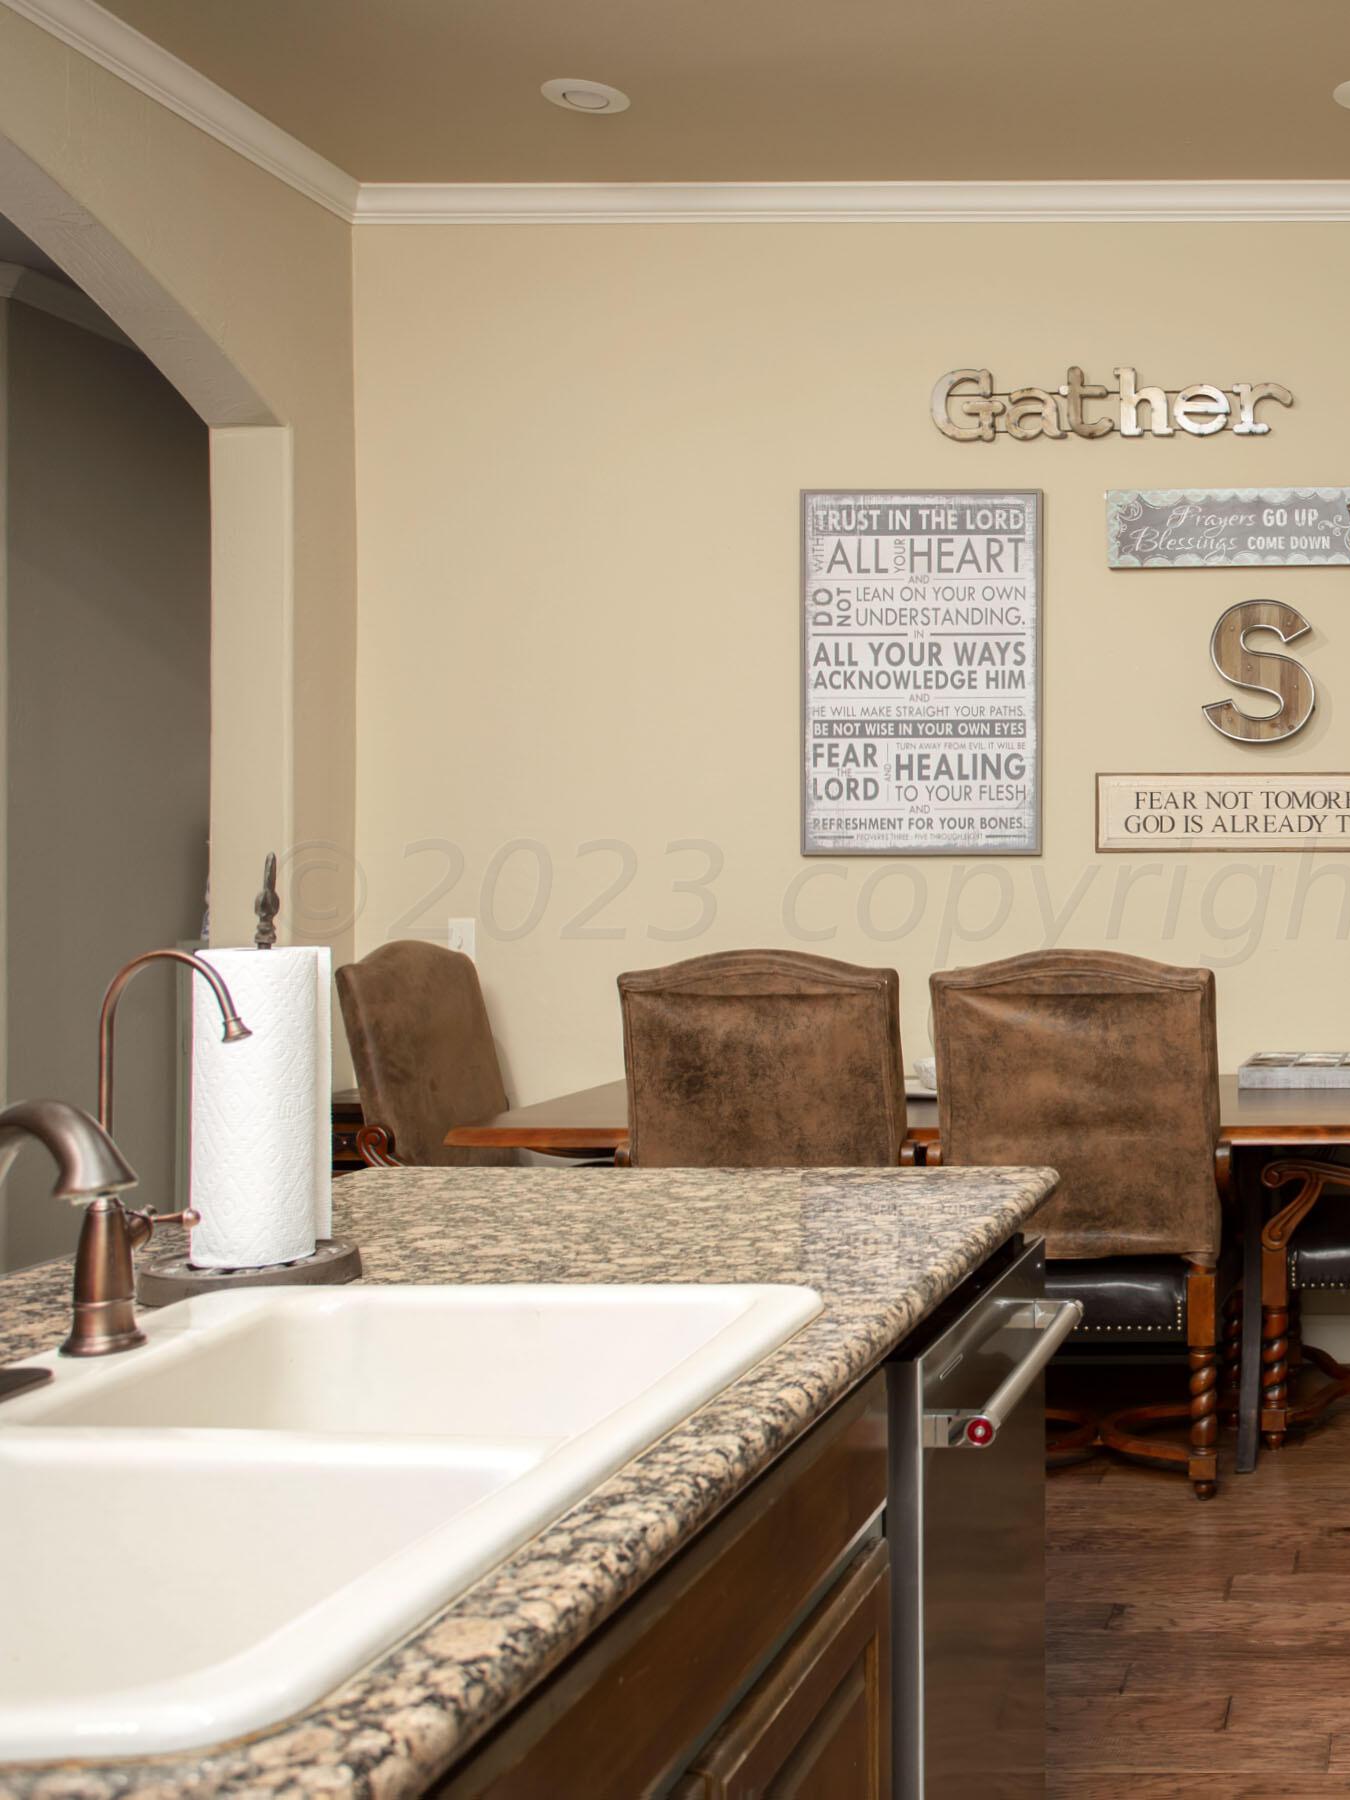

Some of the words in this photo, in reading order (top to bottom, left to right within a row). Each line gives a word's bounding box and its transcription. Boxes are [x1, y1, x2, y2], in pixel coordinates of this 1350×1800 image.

[931, 366, 1294, 441] Gather
[816, 510, 881, 530] TRUST
[888, 510, 910, 530] IN
[919, 510, 958, 530] THE
[966, 510, 1024, 530] LORD
[1167, 506, 1256, 539] Prayers
[1263, 508, 1287, 527] GO
[1295, 508, 1319, 526] UP
[812, 536, 824, 572] WITH
[1128, 528, 1238, 563] Blessings
[1247, 536, 1285, 550] COME
[1290, 536, 1330, 550] DOWN
[826, 538, 889, 574] ALL
[894, 538, 906, 573] YOUR
[909, 538, 1025, 574] HEART
[908, 575, 930, 584] AND
[856, 586, 894, 602] LEAN
[900, 586, 926, 602] ON
[932, 586, 975, 602] YOUR
[981, 586, 1026, 602] OWN
[812, 588, 833, 627] DO
[836, 587, 852, 627] NOT
[856, 607, 1025, 627] UNDERSTANDING.
[913, 629, 924, 639] IN
[812, 642, 858, 667] ALL
[868, 642, 943, 667] YOUR
[953, 642, 1026, 667] WAYS
[813, 670, 978, 690] ACKNOWLEDGE
[985, 670, 1025, 690] HIM
[1201, 599, 1315, 743] S
[909, 694, 930, 703] AND
[813, 706, 827, 717] HE
[830, 706, 856, 717] WILL
[860, 706, 892, 717] MAKE
[896, 706, 950, 717] STRAIGHT
[954, 706, 985, 717] YOUR
[990, 706, 1025, 717] PATHS.
[814, 723, 829, 735] BE
[833, 723, 861, 735] NOT
[864, 723, 895, 735] WISE
[899, 723, 912, 735] IN
[917, 723, 953, 735] YOUR
[958, 723, 991, 735] OWN
[994, 723, 1025, 735] EYES
[812, 743, 878, 768] FEAR
[896, 742, 917, 750] TURN
[919, 742, 942, 750] AWAY
[944, 742, 966, 750] FROM
[988, 742, 994, 750] IT
[996, 742, 1015, 750] WILL
[1017, 742, 1026, 750] BE
[837, 768, 853, 777] THE
[895, 753, 1026, 781] HEALING
[812, 778, 879, 801] LORD
[895, 785, 918, 801] TO
[926, 785, 972, 801] YOUR
[979, 785, 1026, 801] FLESH
[909, 805, 930, 814] AND
[1135, 791, 1196, 811] FEAR
[1204, 791, 1253, 811] NOT
[813, 818, 904, 830] REFRESHMENT
[908, 818, 934, 830] FOR
[939, 818, 975, 830] YOUR
[980, 818, 1026, 830] BONES.
[1124, 814, 1176, 834] GOD
[1183, 814, 1203, 834] IS
[1212, 814, 1328, 834] ALREADY
